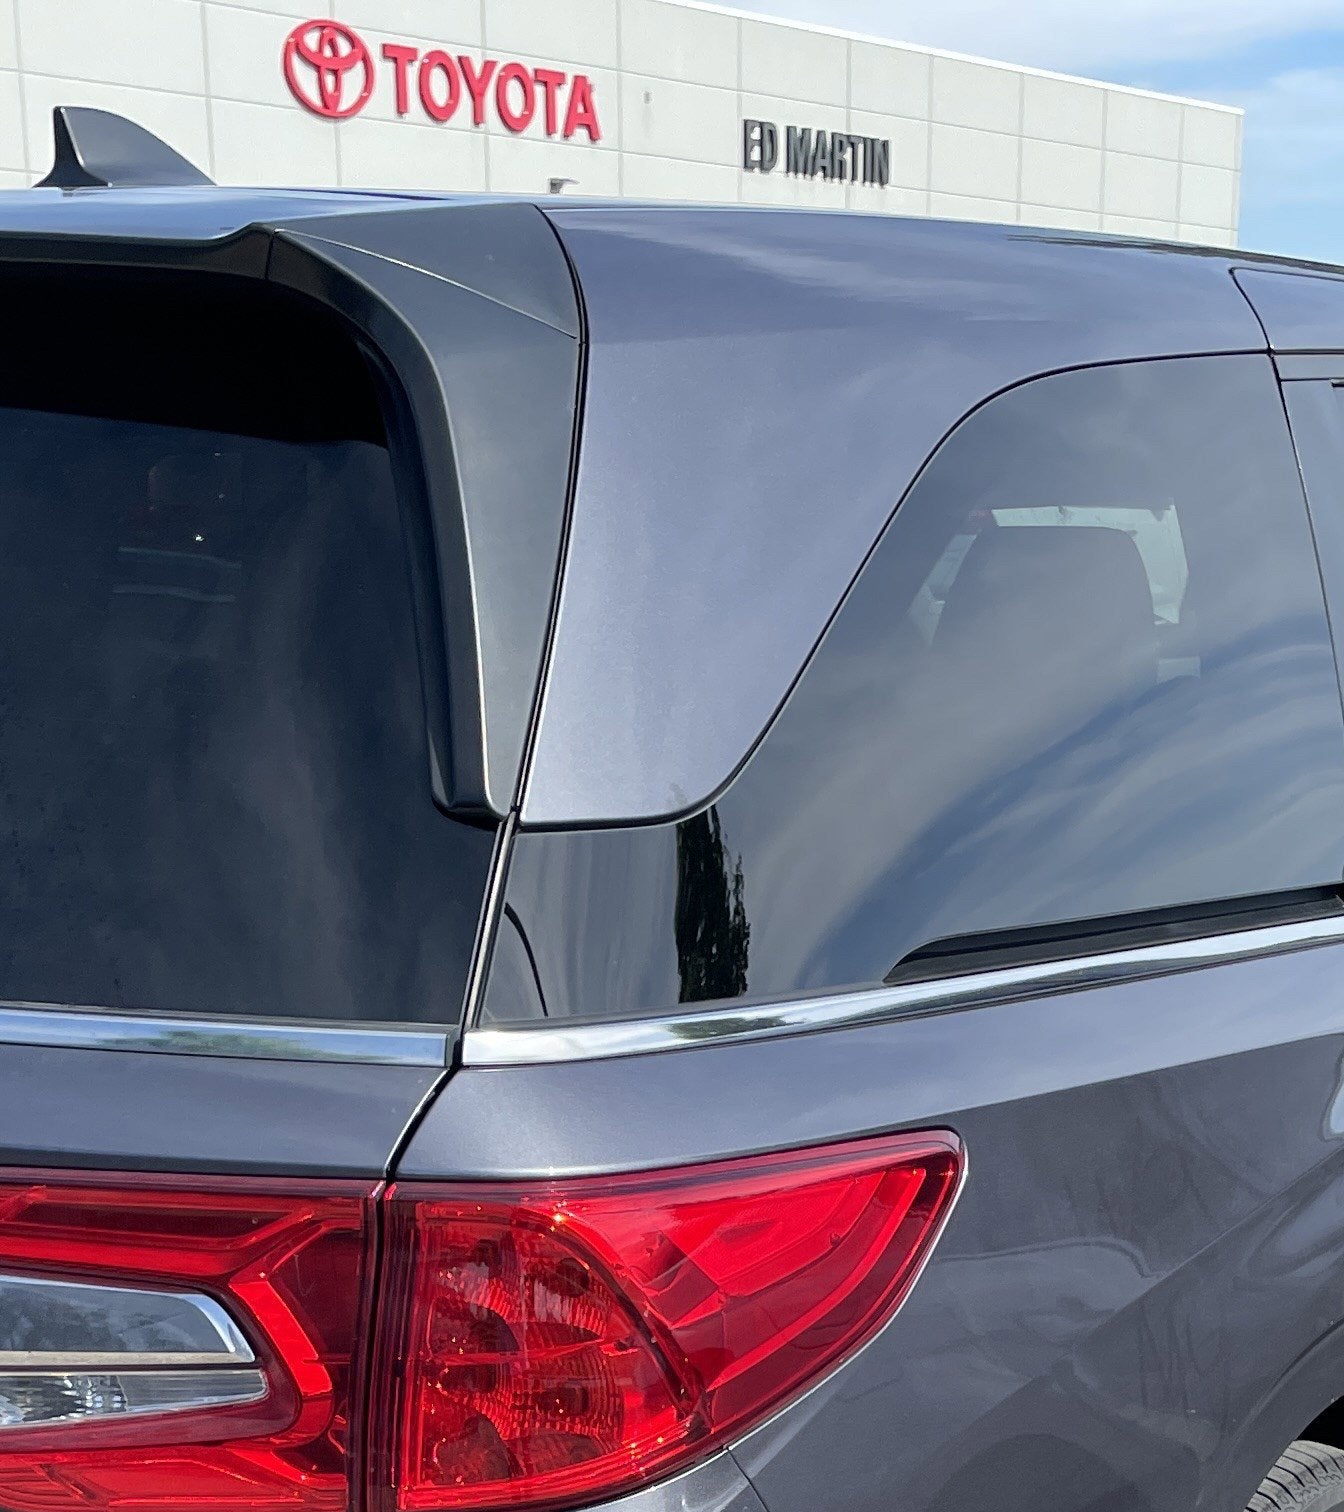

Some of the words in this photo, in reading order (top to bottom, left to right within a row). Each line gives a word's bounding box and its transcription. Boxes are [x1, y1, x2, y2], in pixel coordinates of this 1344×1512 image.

[381, 43, 603, 142] TOYOTA
[743, 119, 778, 173] ED
[785, 125, 890, 189] MARTIN
